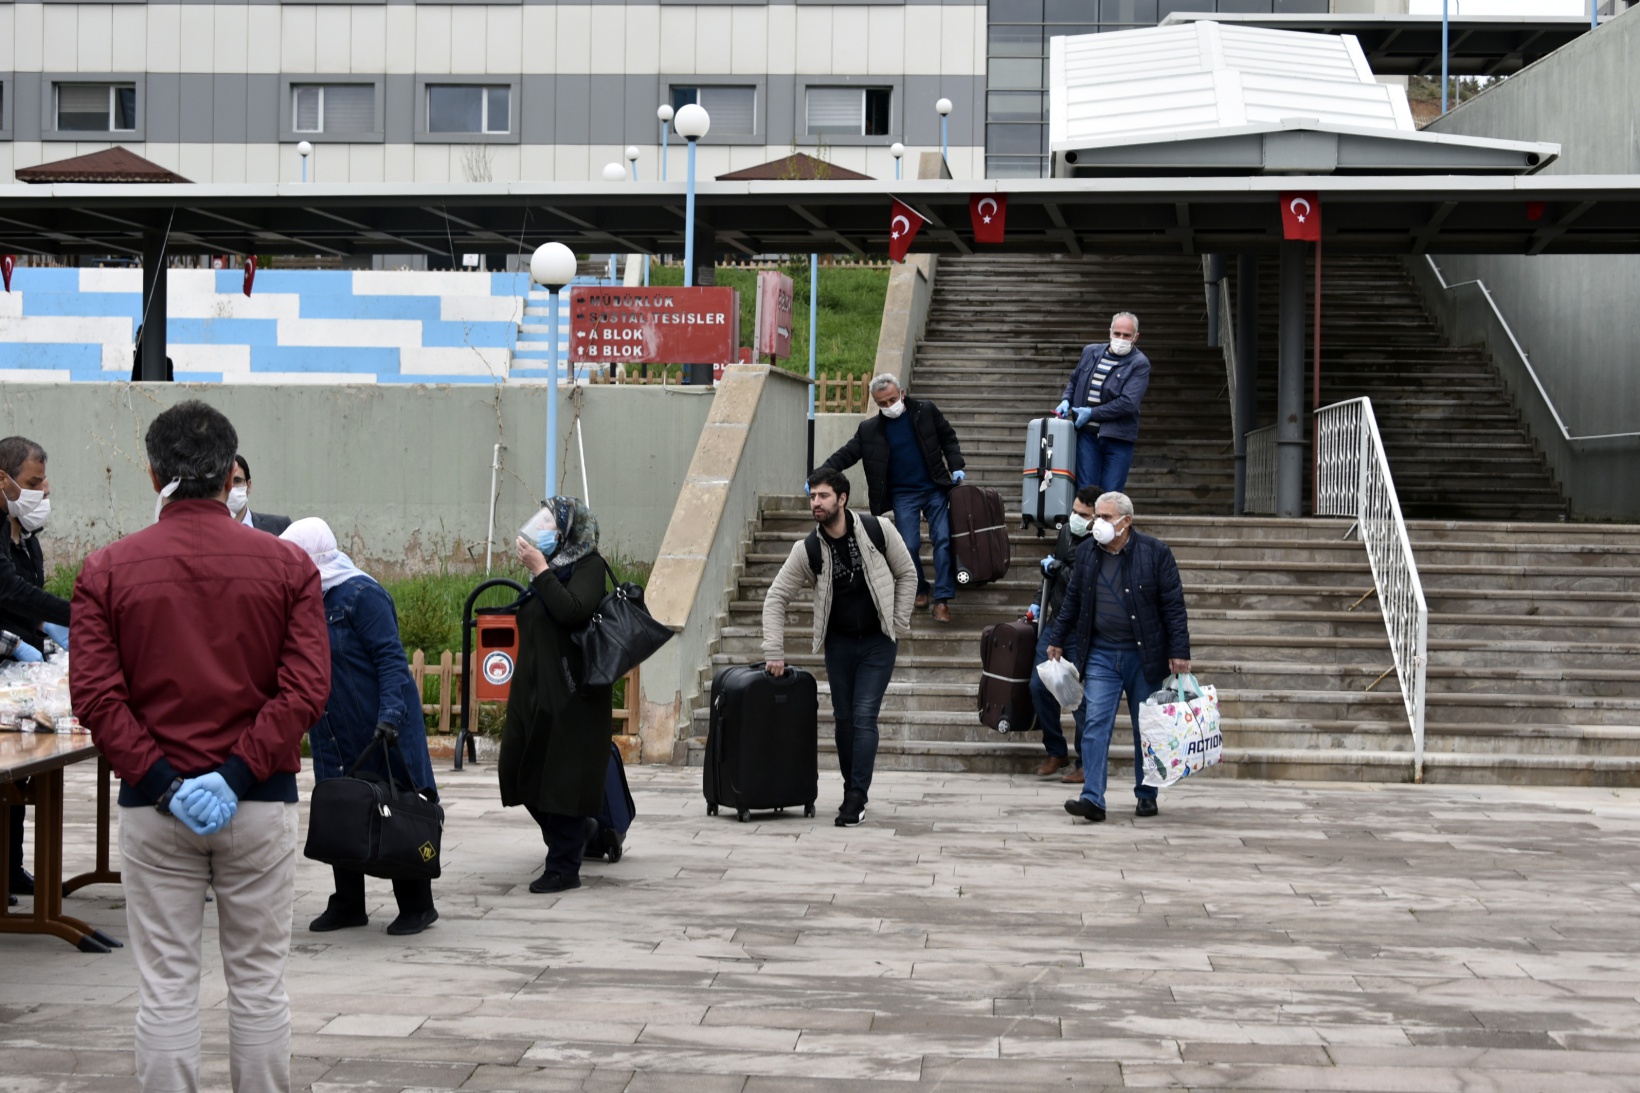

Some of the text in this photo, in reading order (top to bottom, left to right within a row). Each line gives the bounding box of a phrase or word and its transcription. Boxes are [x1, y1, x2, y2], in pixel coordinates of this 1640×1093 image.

[589, 293, 674, 307] MÜDÜRLÜK
[589, 310, 725, 324] SOSYAL TESİSLER
[589, 329, 643, 340] A BLOK
[588, 345, 643, 356] B BLOK
